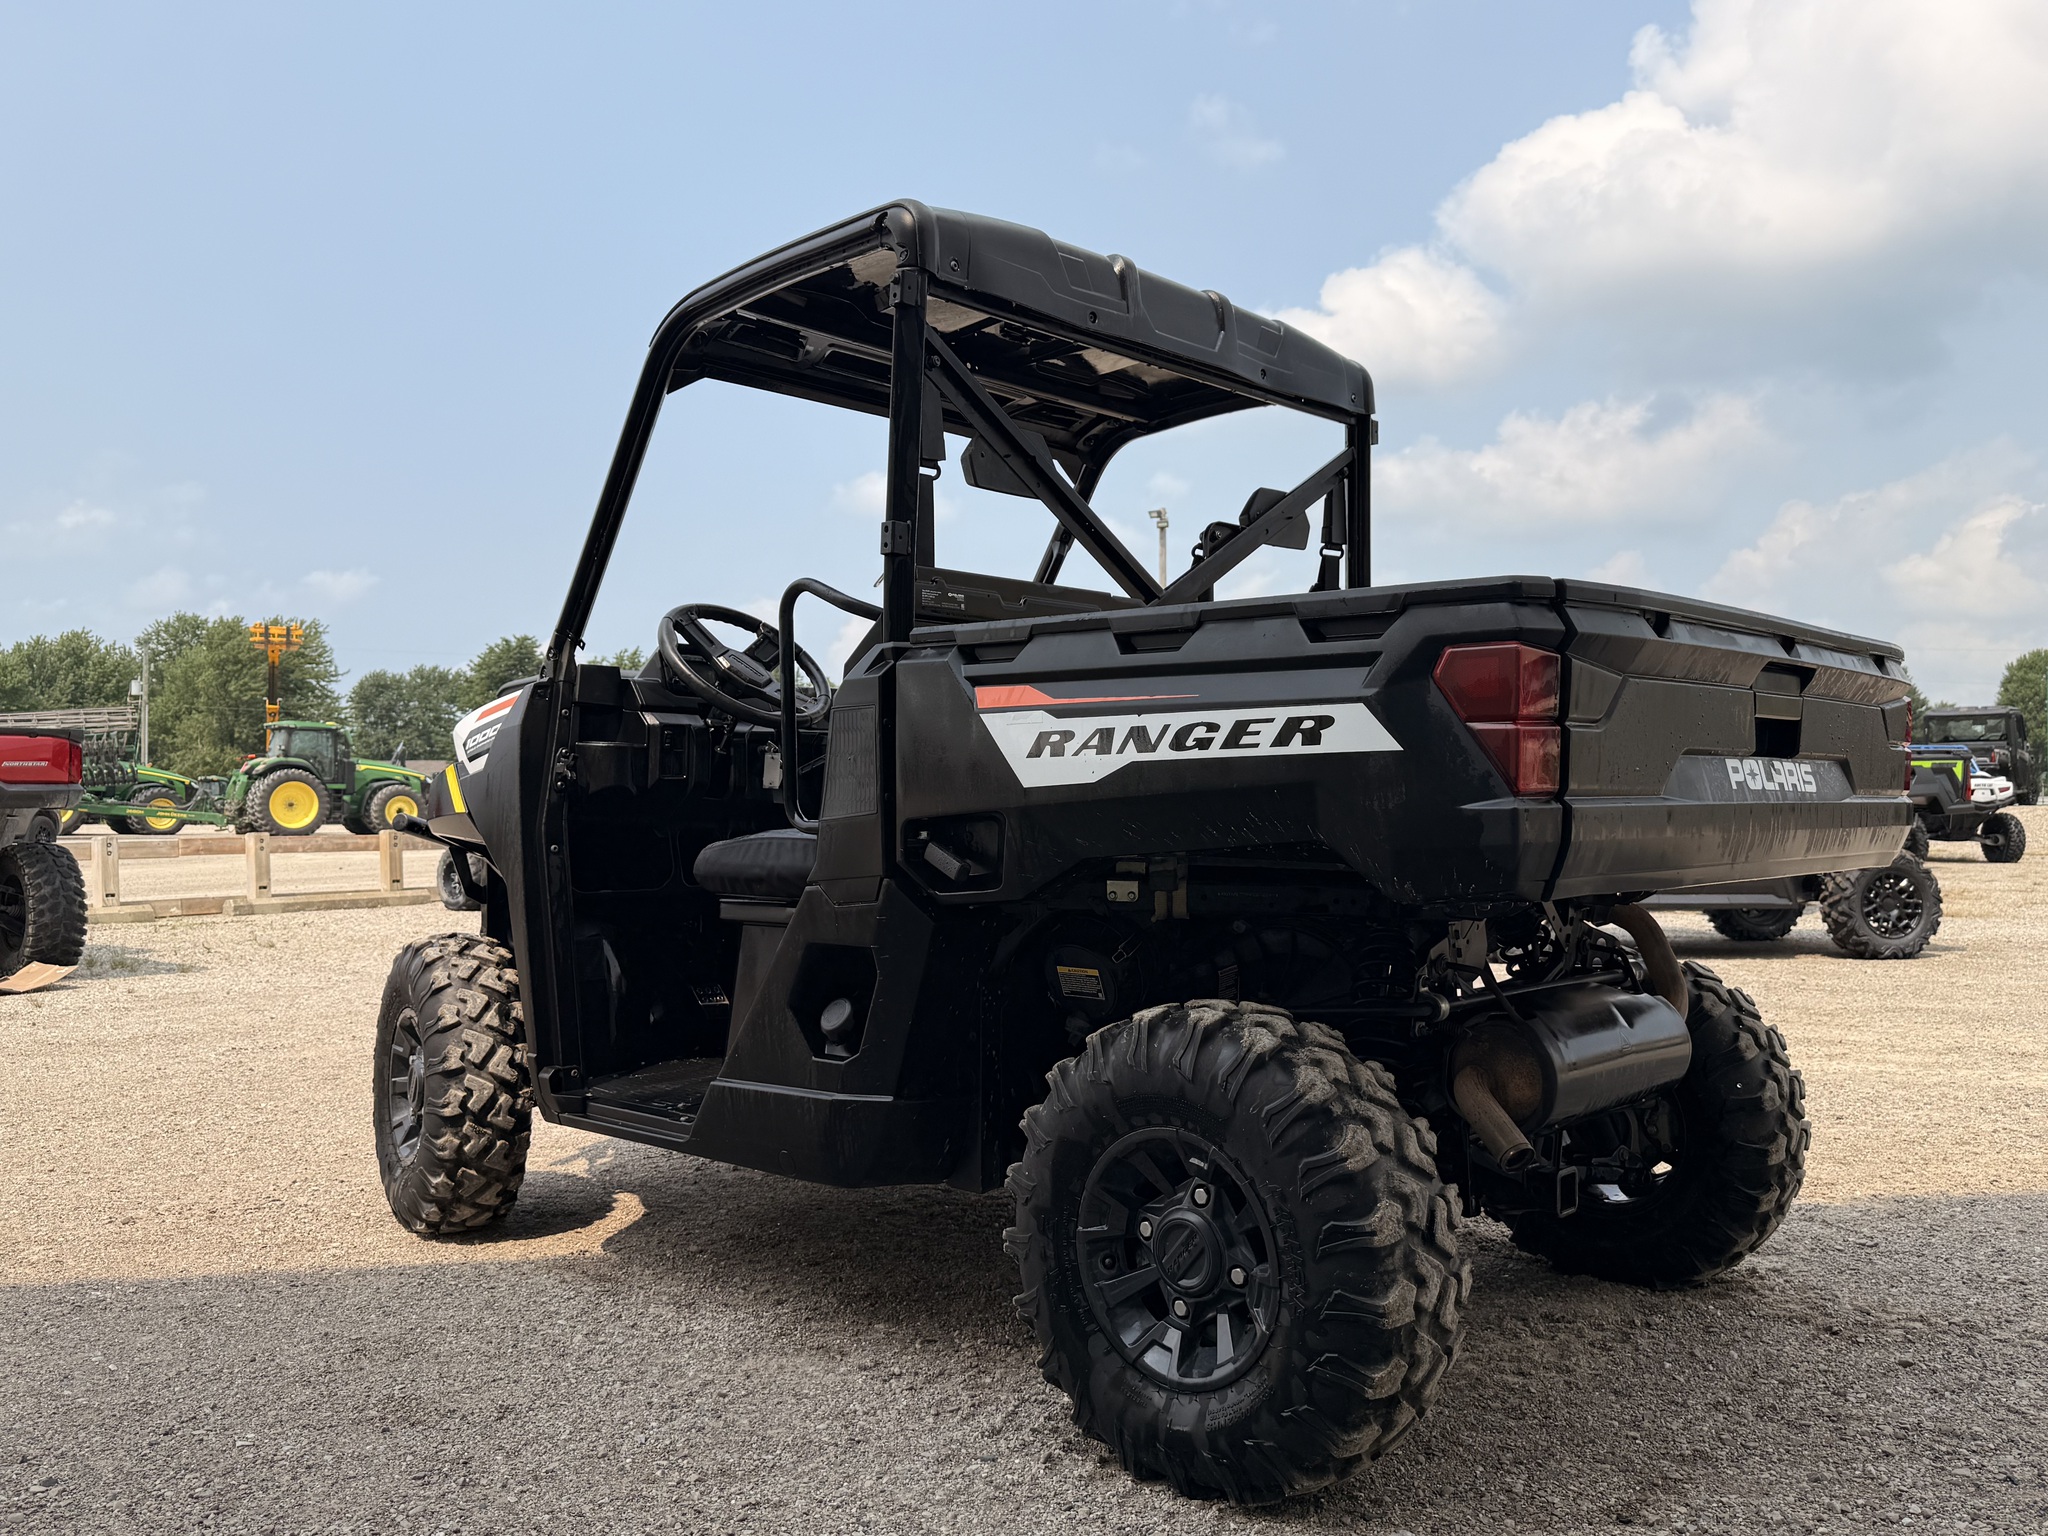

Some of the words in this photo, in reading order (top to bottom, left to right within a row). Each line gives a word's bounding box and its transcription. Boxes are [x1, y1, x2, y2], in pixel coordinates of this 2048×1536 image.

[465, 722, 503, 751] 1000
[1025, 714, 1336, 759] RANGER
[1724, 758, 1817, 793] POLARIS
